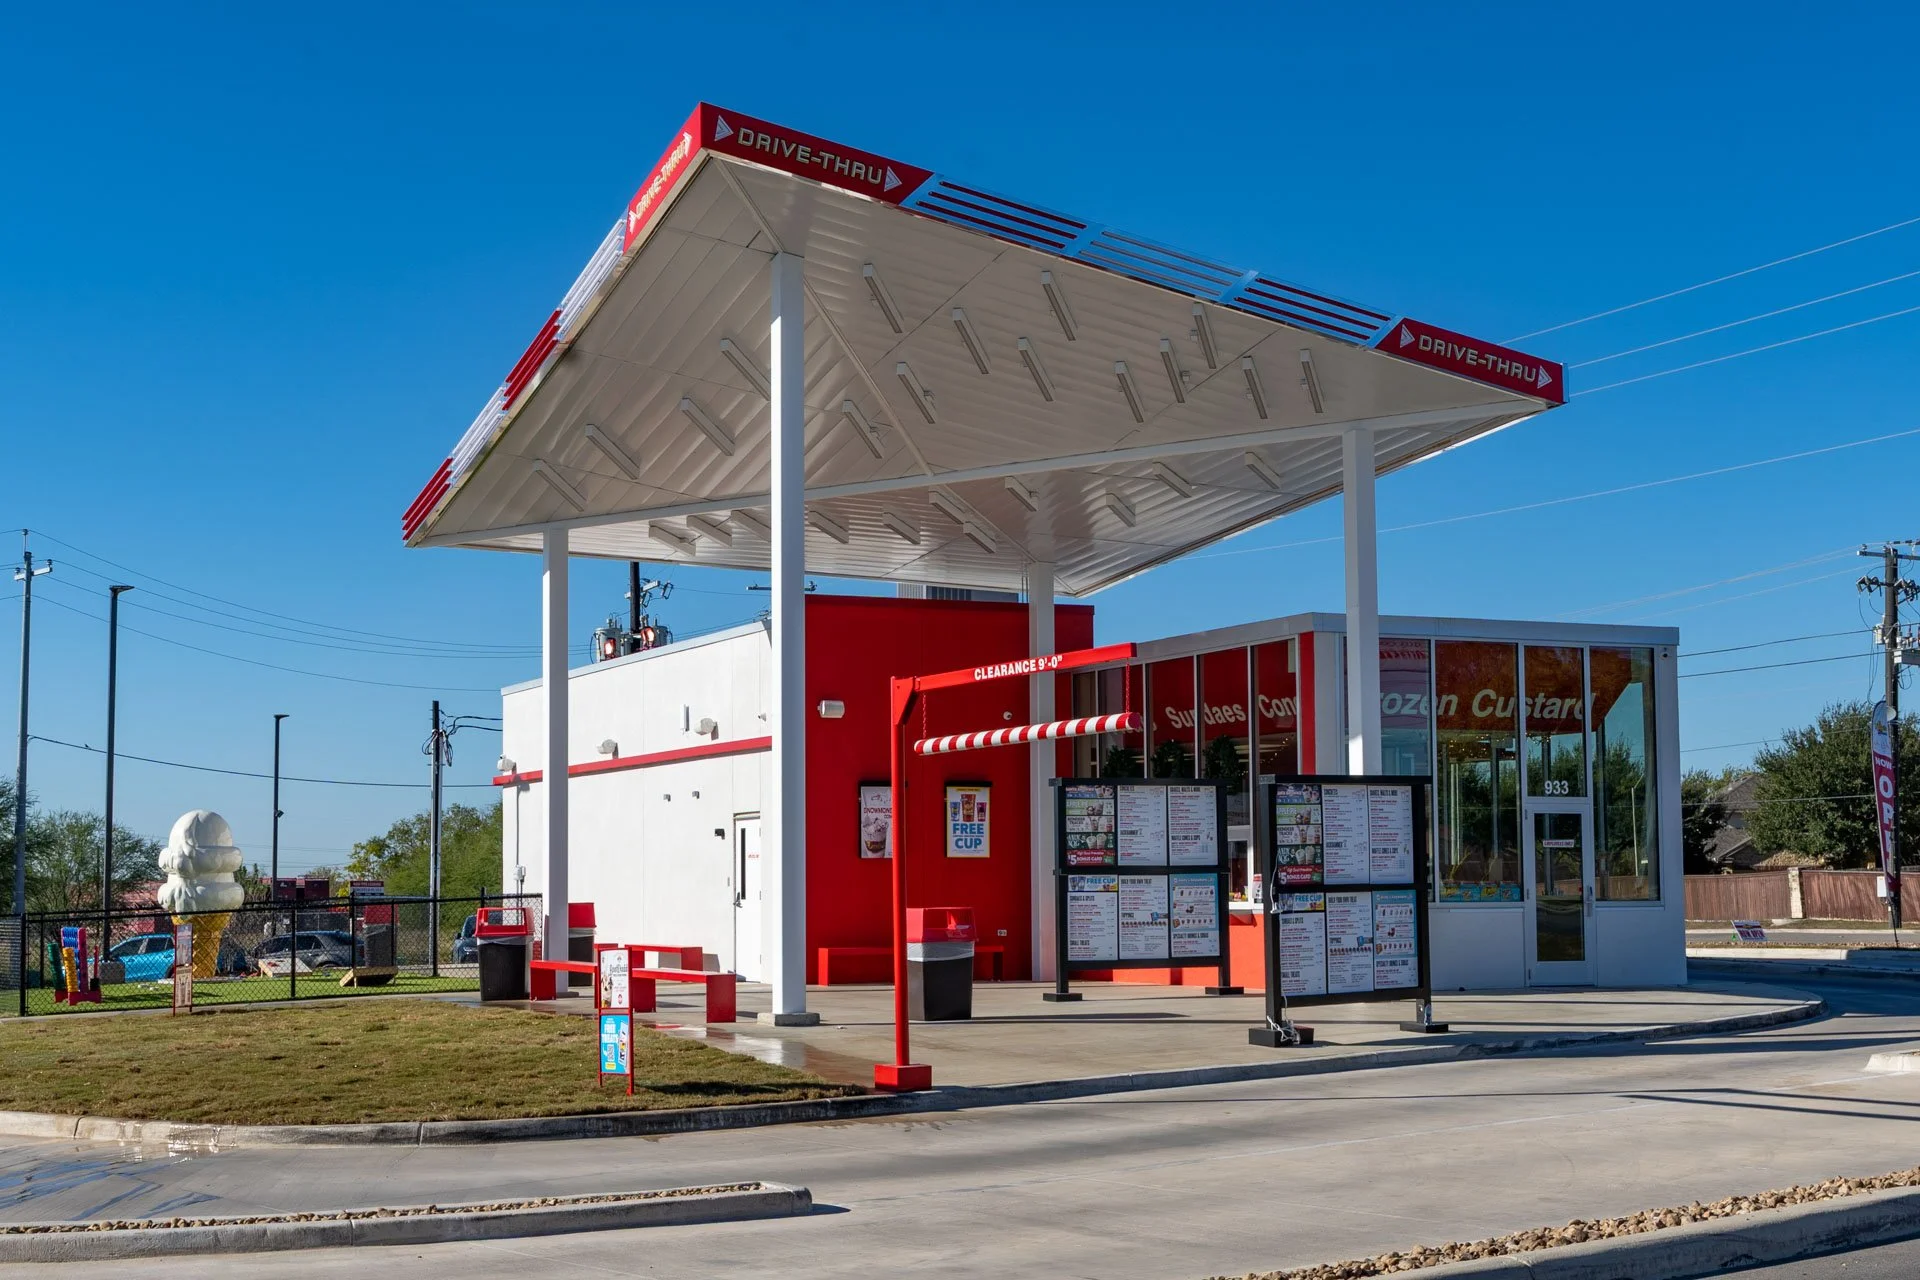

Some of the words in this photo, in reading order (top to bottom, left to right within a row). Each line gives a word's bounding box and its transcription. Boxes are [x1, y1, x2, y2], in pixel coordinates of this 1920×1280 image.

[737, 127, 883, 185] DRIVE-THRU
[635, 139, 686, 220] DRIVE-THRU
[1418, 334, 1536, 383] DRIVE-THRU
[974, 659, 1037, 681] CLEARANCE
[1165, 703, 1247, 729] Sundaes
[1544, 780, 1569, 795] 933
[952, 823, 984, 835] FREE
[955, 838, 982, 849] CUP
